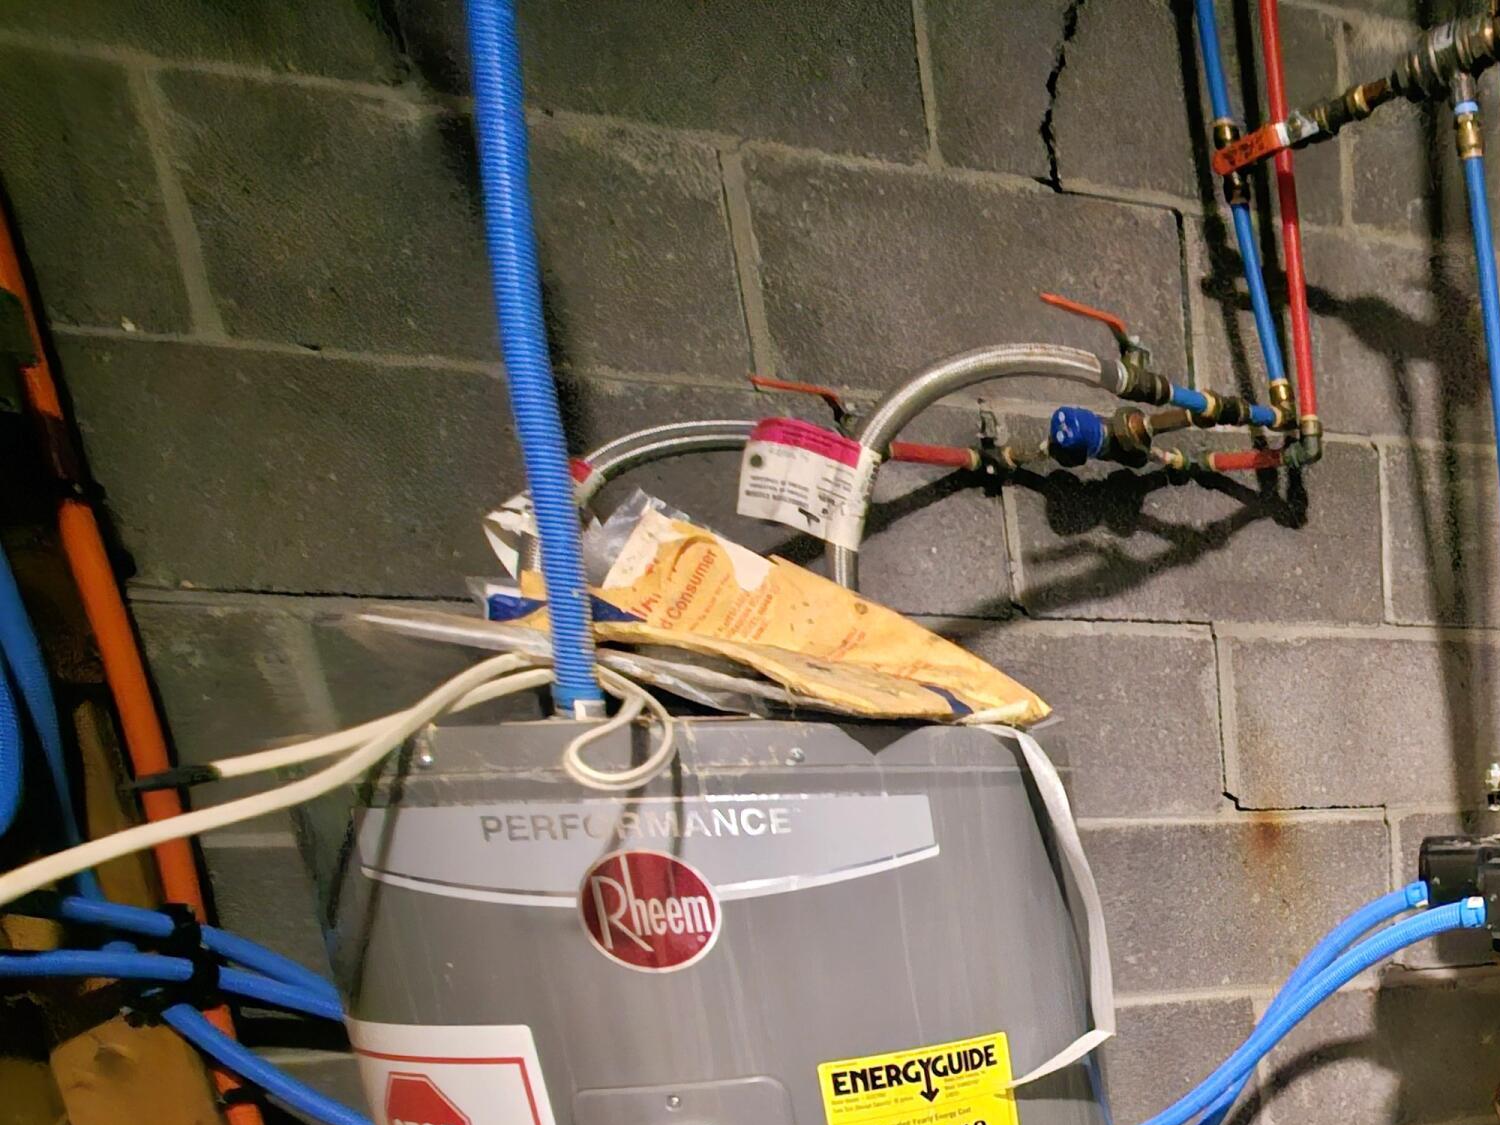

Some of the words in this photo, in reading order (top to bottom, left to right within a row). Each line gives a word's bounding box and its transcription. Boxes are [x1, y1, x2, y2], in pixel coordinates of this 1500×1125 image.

[667, 547, 718, 621] Consumer
[479, 808, 793, 842] PERFORMANCE
[590, 854, 713, 952] Rheem
[831, 1044, 998, 1097] ENERGYGUIDE
